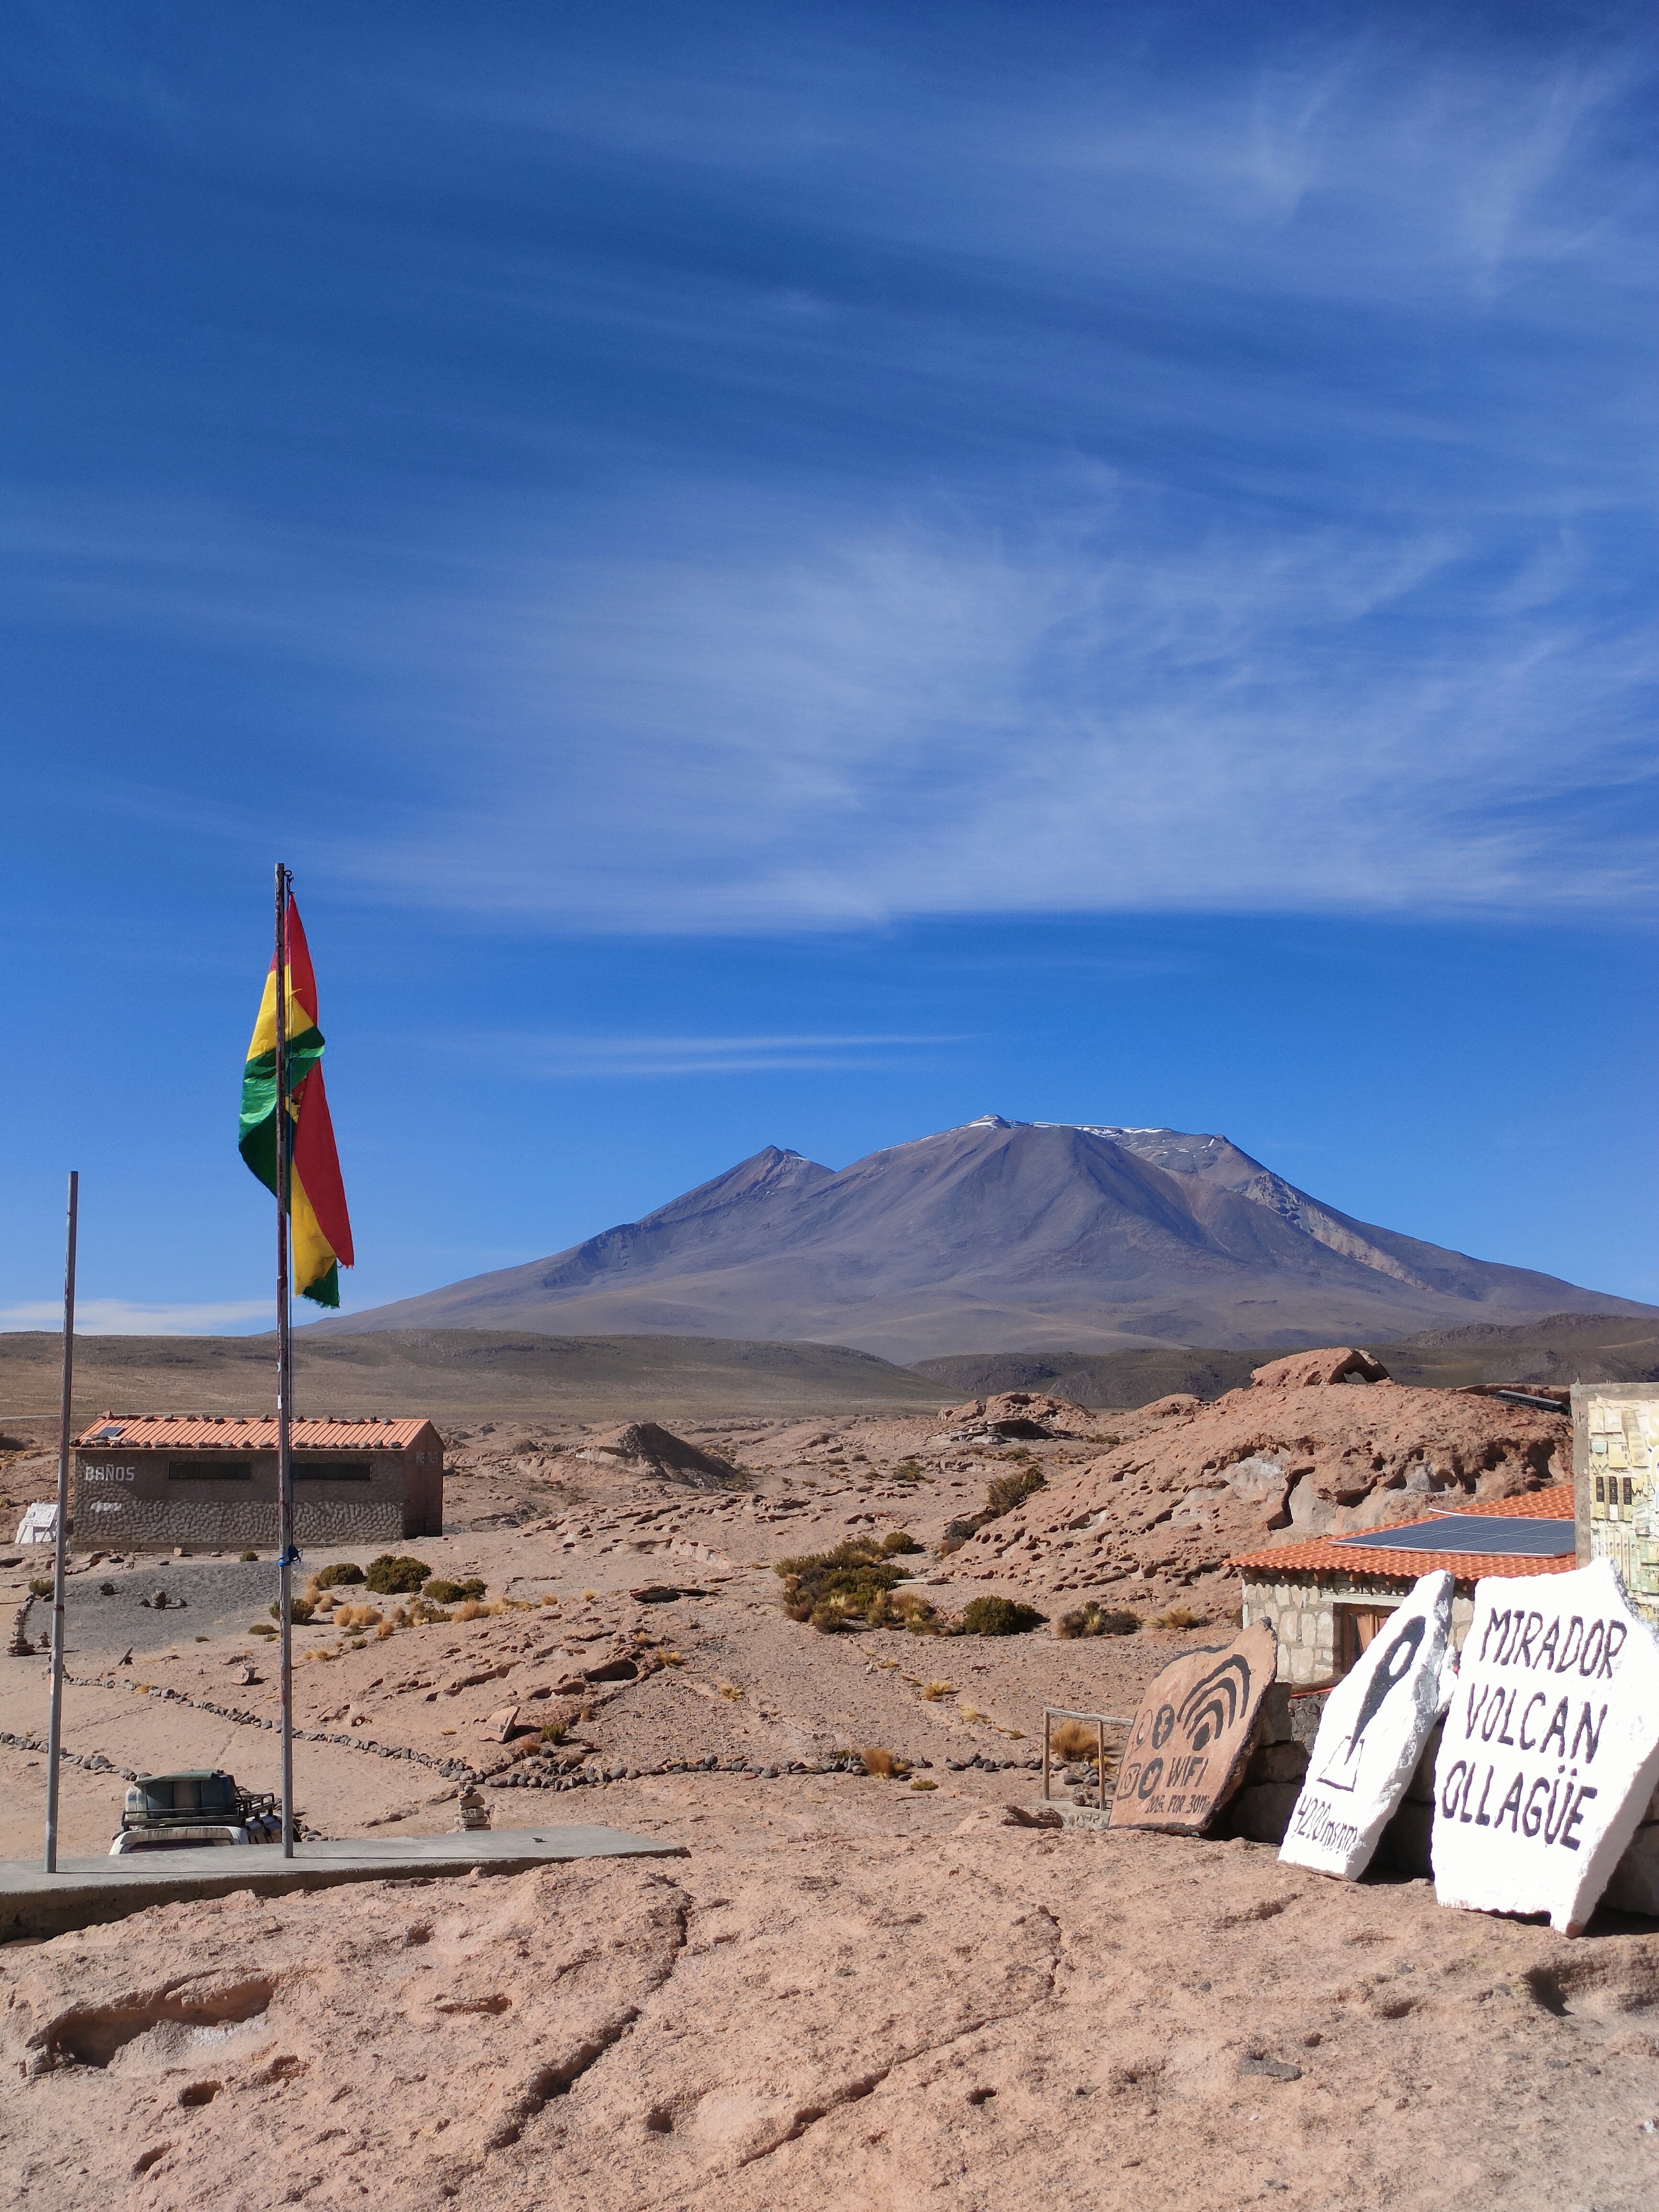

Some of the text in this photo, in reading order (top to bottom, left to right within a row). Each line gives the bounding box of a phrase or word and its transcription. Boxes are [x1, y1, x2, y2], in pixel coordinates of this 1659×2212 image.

[86, 1464, 134, 1481] BAÑOS
[1479, 1607, 1627, 1679] MIRADOR
[1466, 1683, 1608, 1764] VOLCAN
[1166, 1756, 1209, 1787] WIFI
[1167, 1794, 1186, 1814] FOR
[1442, 1760, 1598, 1850] OLLAGÜE
